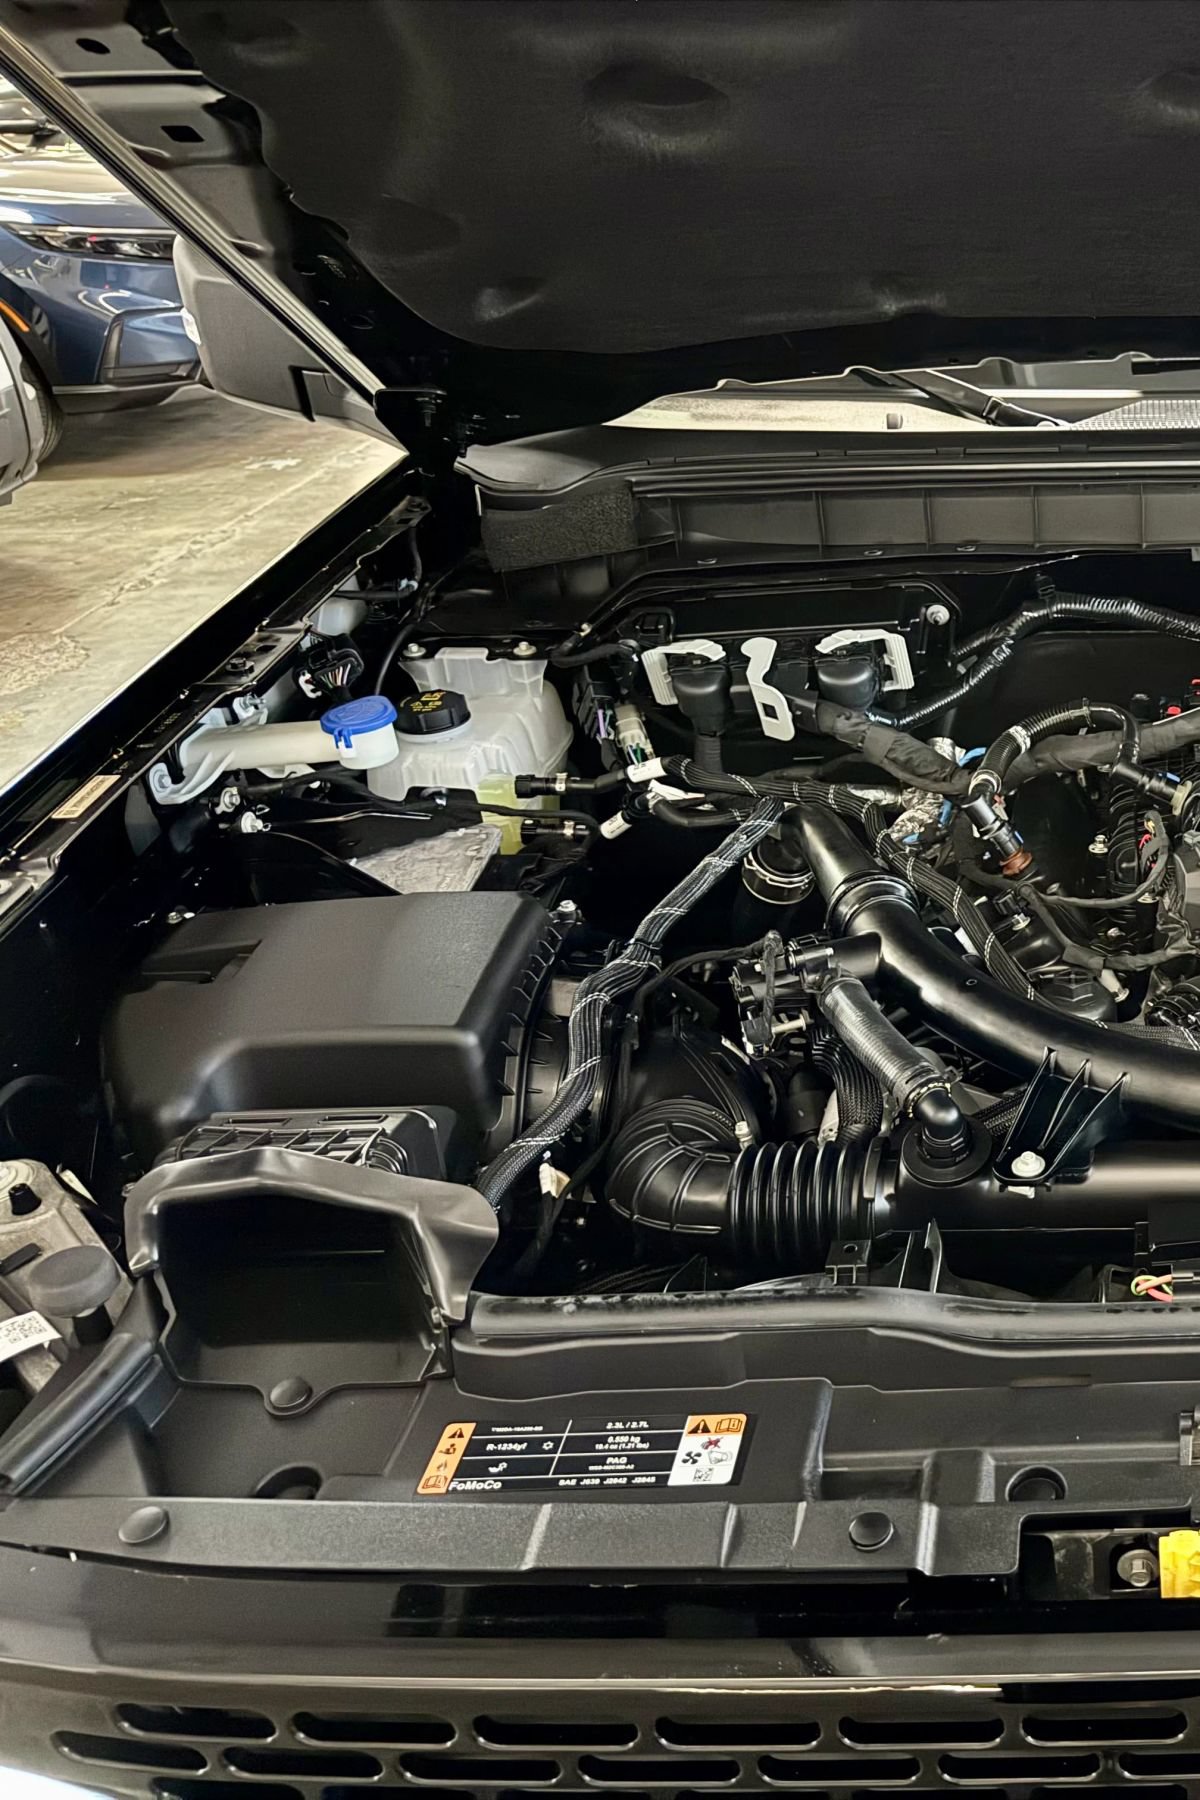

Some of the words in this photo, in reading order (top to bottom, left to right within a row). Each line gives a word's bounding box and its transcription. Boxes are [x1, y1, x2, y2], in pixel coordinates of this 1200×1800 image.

[630, 1435, 641, 1444] kg
[485, 1442, 528, 1451] R-1234yf
[448, 1480, 503, 1491] FoMoCo
